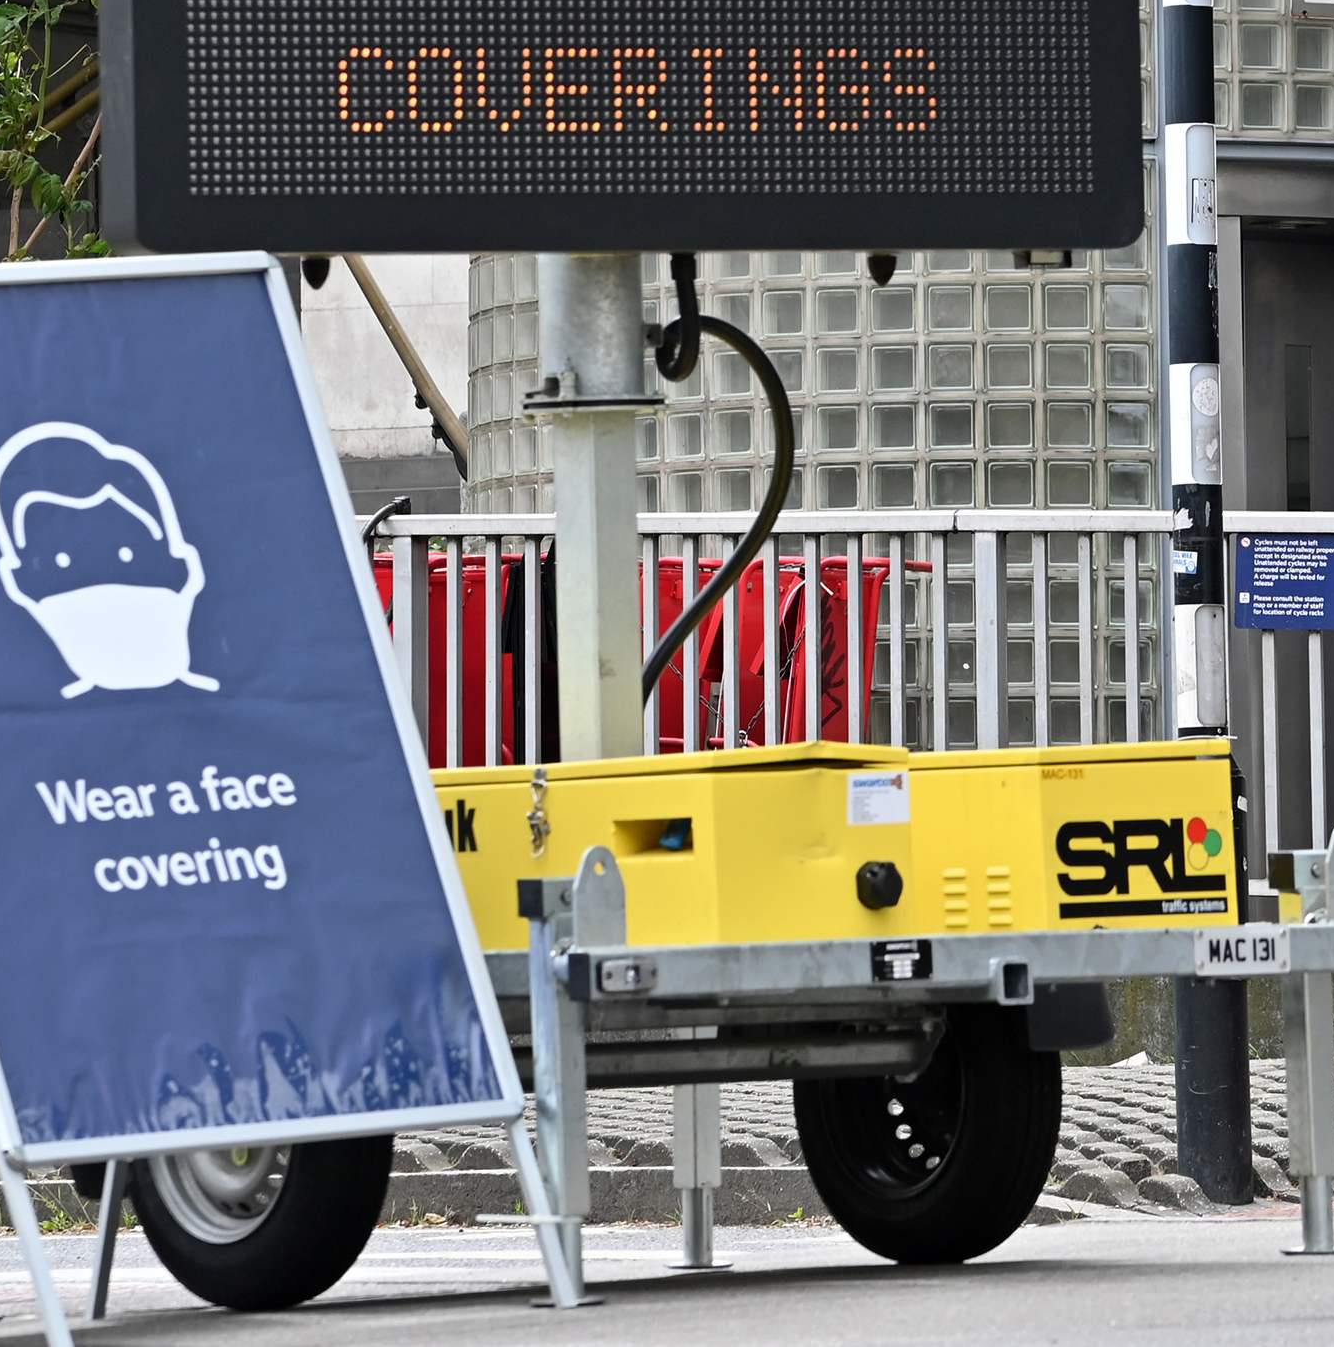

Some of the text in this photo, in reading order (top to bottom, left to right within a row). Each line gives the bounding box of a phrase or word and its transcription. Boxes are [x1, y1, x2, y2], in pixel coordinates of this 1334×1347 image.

[339, 47, 936, 133] COVERINGS
[1288, 560, 1306, 568] cycles
[1041, 769, 1084, 780] MAC-131
[35, 765, 297, 825] Wear a face
[94, 837, 287, 892] covering
[1055, 818, 1227, 896] SRL
[1162, 898, 1226, 914] traffic systems
[1208, 937, 1276, 963] MAC 131
